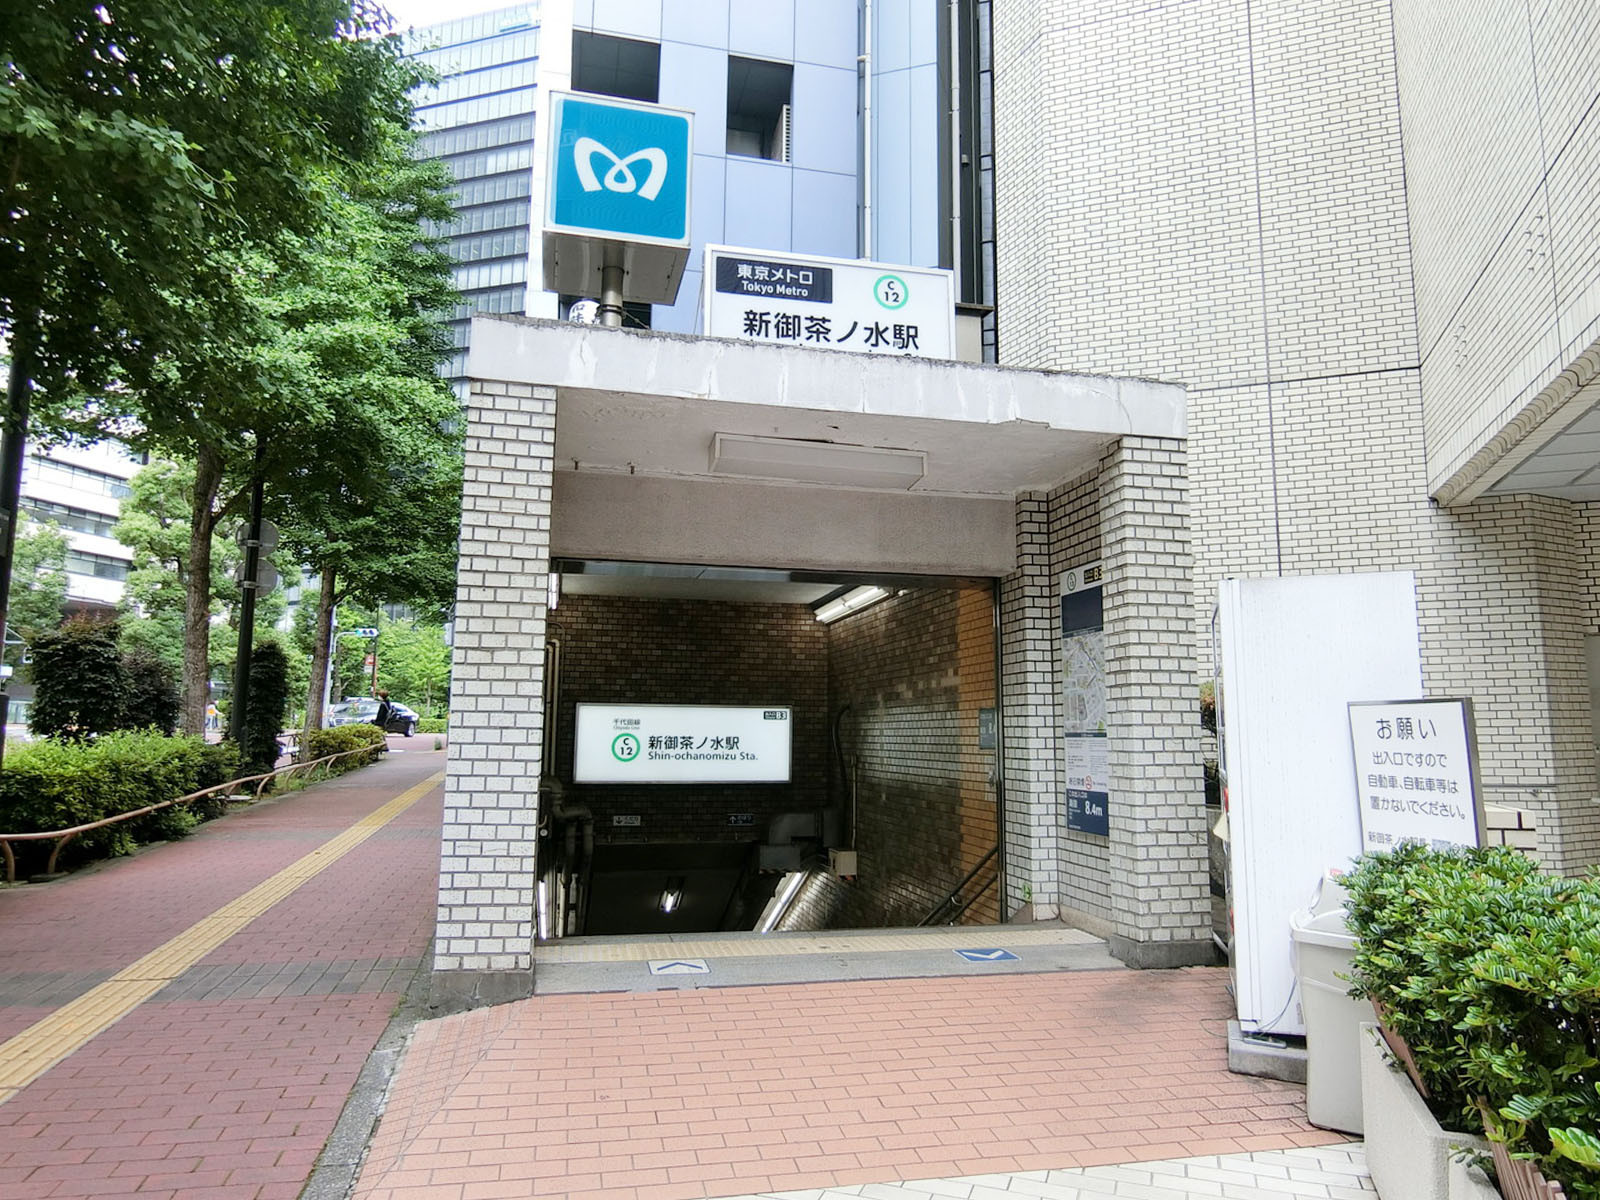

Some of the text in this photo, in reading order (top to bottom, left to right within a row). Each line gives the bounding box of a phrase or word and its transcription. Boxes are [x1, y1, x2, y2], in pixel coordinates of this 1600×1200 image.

[736, 263, 813, 285] 東京メトロ
[741, 280, 809, 297] Tokyo Metro
[887, 280, 895, 291] C
[883, 290, 900, 303] 12
[743, 309, 919, 350] 新御茶ノ水駅
[775, 711, 787, 719] B3
[1376, 717, 1437, 740] お願い
[622, 737, 630, 746] C
[648, 735, 740, 751] 新御茶ノ水駅
[620, 746, 633, 756] 12
[648, 750, 759, 761] Shin-ochanomizu Sta.
[1372, 751, 1448, 768] 出入口ですので
[1367, 773, 1459, 794] 自動車、自転車等は
[1084, 800, 1103, 817] 8.4m
[1369, 795, 1466, 820] 置かないでください。
